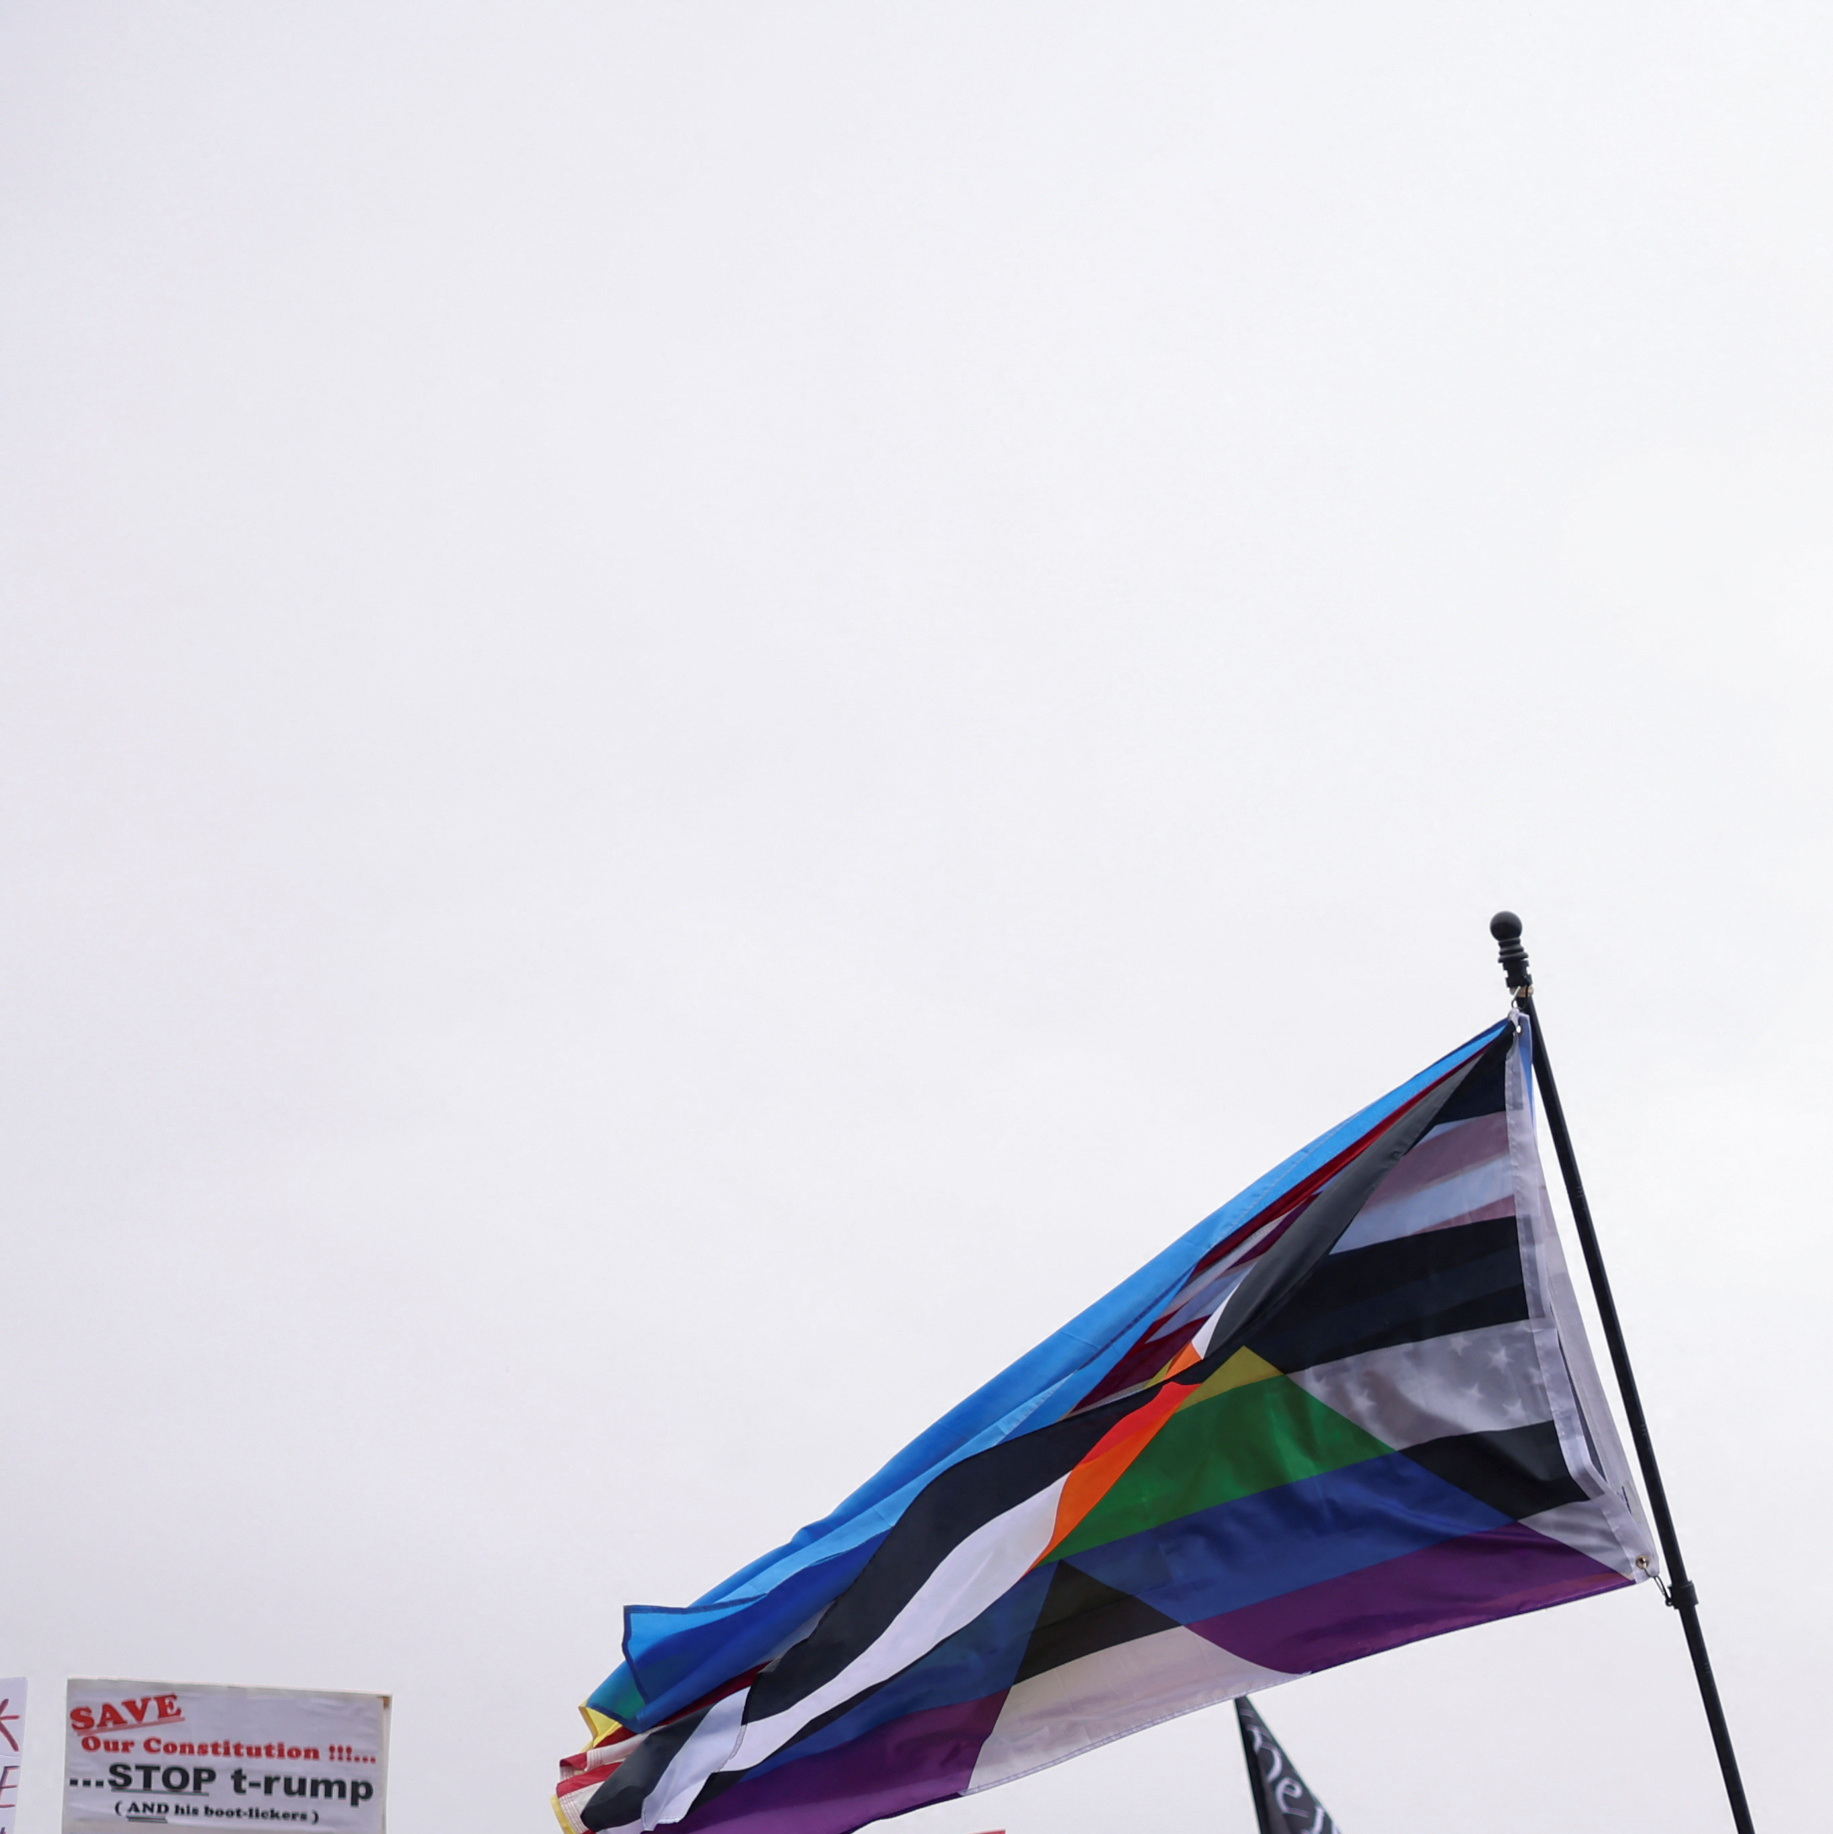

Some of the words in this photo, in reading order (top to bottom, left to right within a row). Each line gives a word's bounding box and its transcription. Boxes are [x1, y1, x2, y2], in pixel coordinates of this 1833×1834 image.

[69, 1693, 183, 1731] SAVE
[81, 1736, 135, 1754] Our
[143, 1738, 320, 1760] Constitution
[231, 1767, 374, 1806] t-rump
[128, 1803, 169, 1818] AND
[174, 1803, 199, 1816] his
[204, 1805, 308, 1822] boot-lickers
